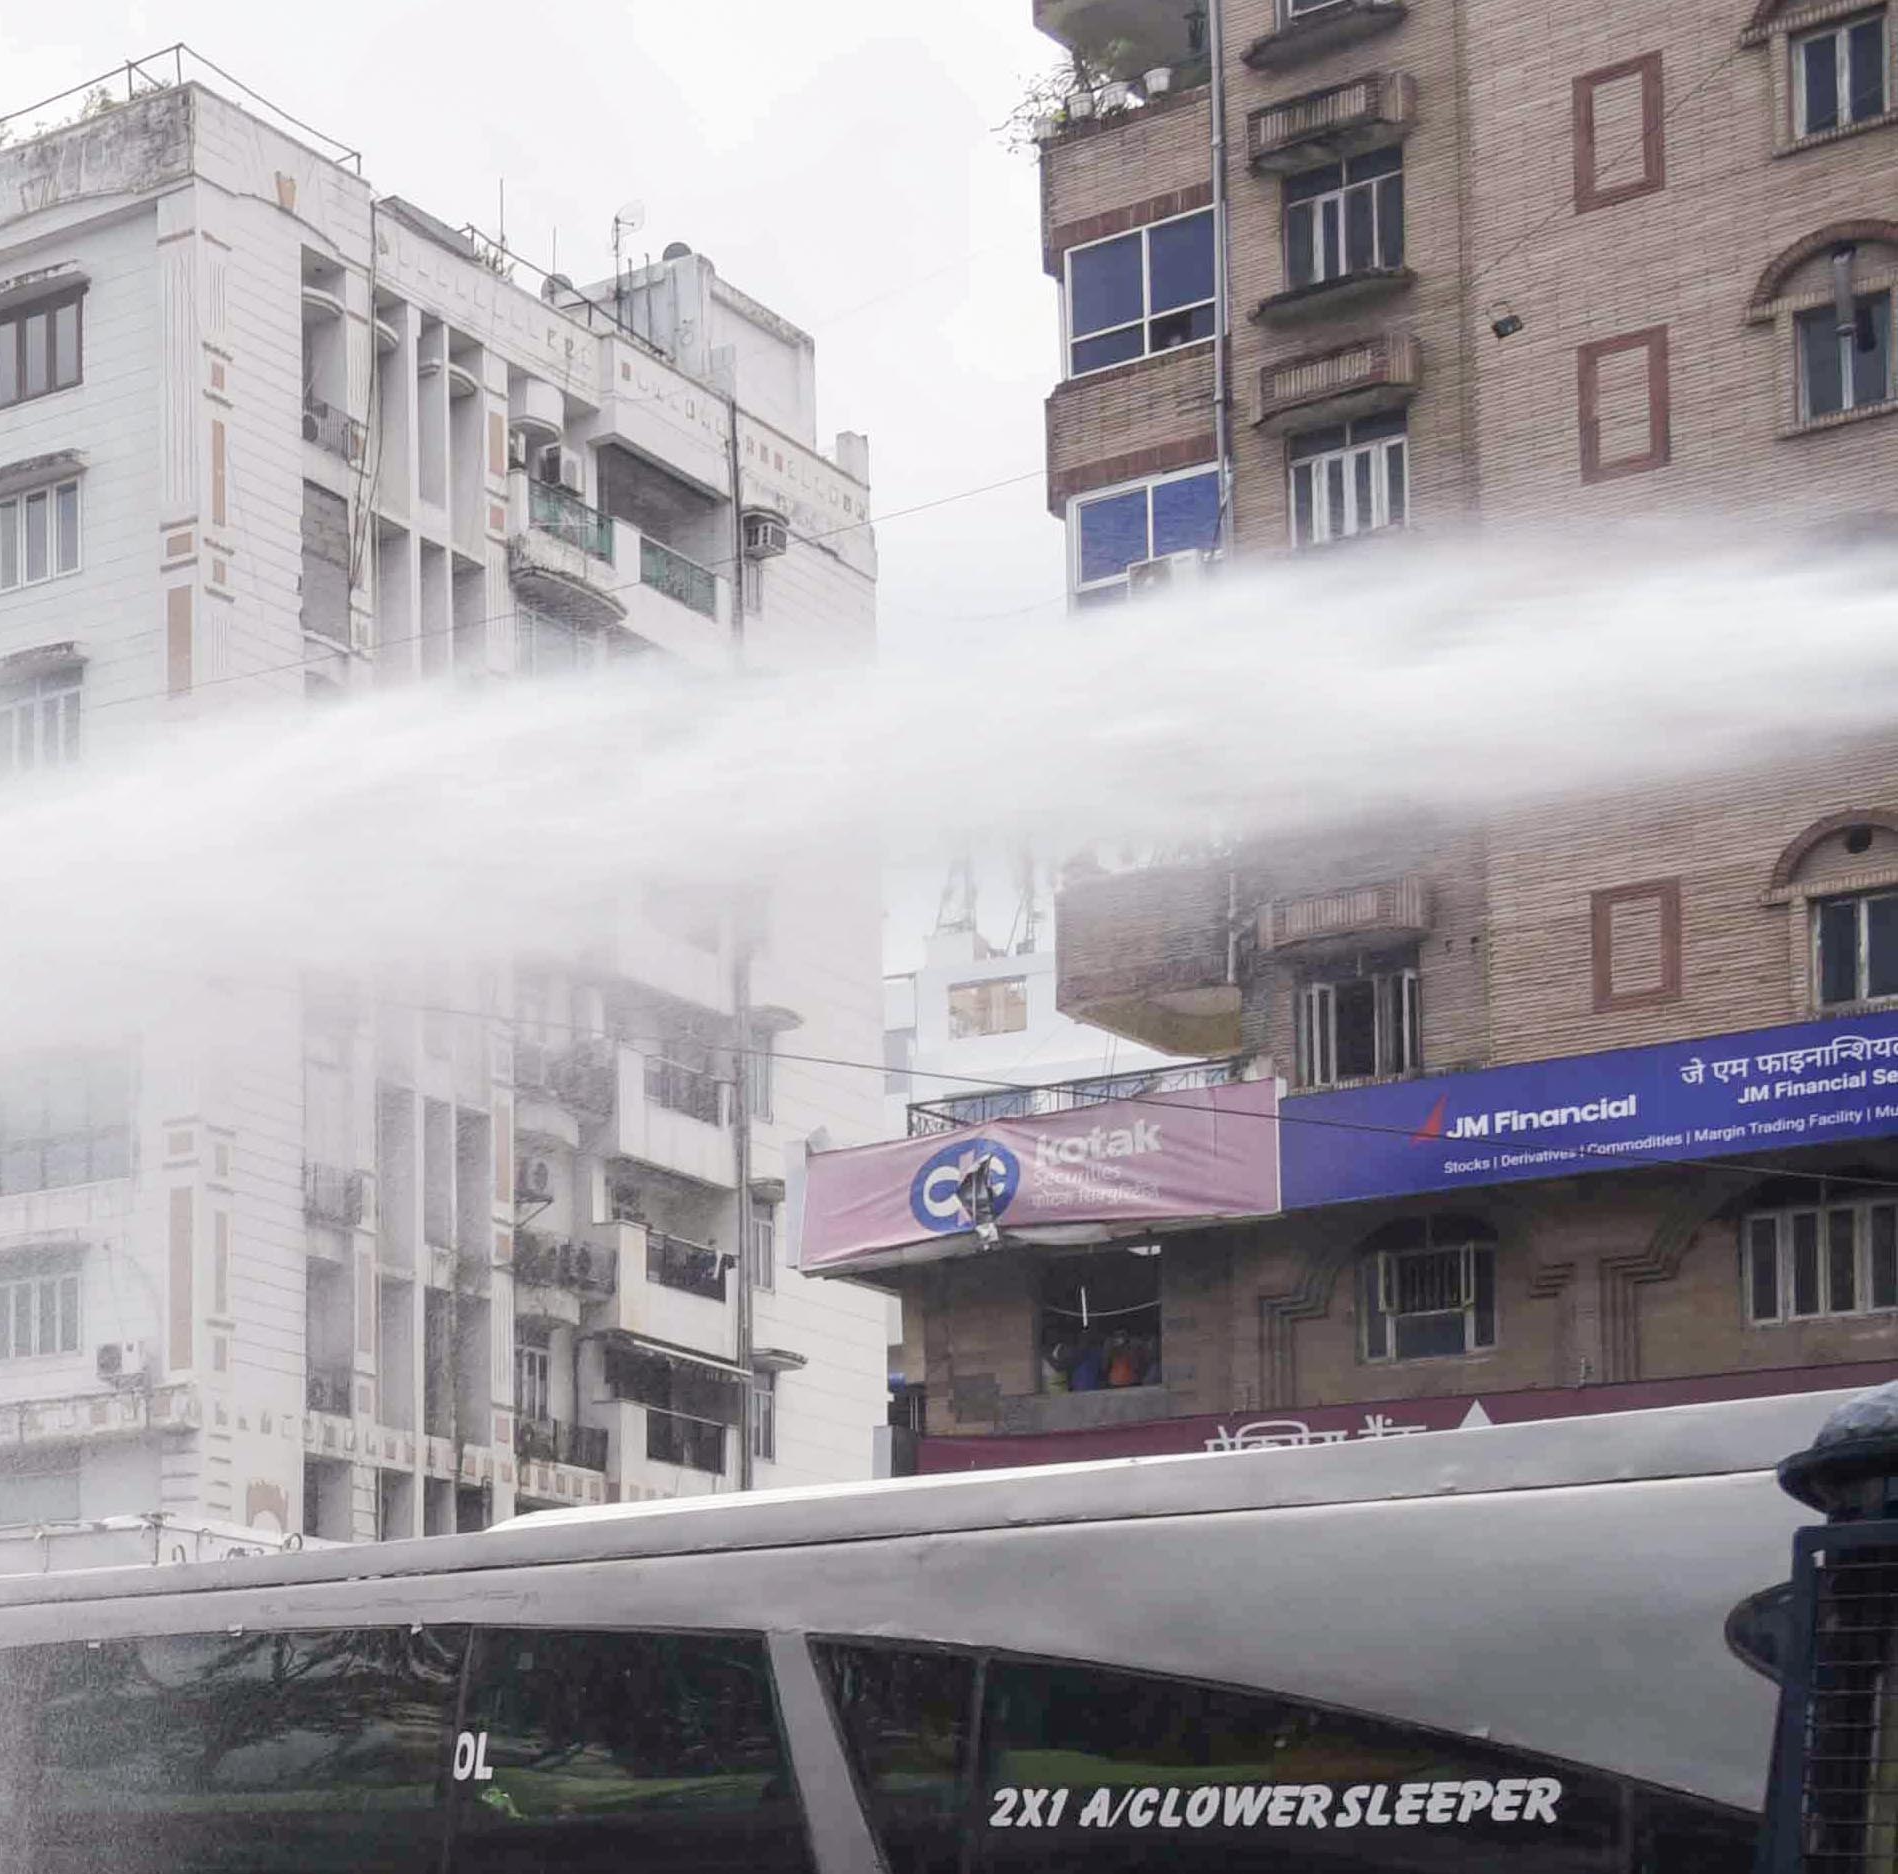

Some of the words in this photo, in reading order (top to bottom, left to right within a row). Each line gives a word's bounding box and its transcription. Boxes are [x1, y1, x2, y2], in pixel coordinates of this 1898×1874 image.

[1680, 1057, 1706, 1085] जे
[1712, 1057, 1749, 1083] एम
[1737, 1086, 1770, 1104] JM
[1775, 1070, 1866, 1099] Financial
[1447, 1114, 1488, 1138] JM
[1495, 1094, 1636, 1134] Financial
[1035, 1118, 1162, 1167] kotak
[1444, 1158, 1490, 1174] Stocks
[1501, 1148, 1577, 1167] Derivatives
[1587, 1132, 1683, 1155] Commodities
[1694, 1125, 1745, 1142] Margin
[1750, 1116, 1804, 1134] Trading
[1809, 1109, 1863, 1127] Facility
[1033, 1164, 1121, 1187] Securities
[989, 1787, 1070, 1828] 2X1
[1334, 1777, 1562, 1829] SLEEPER
